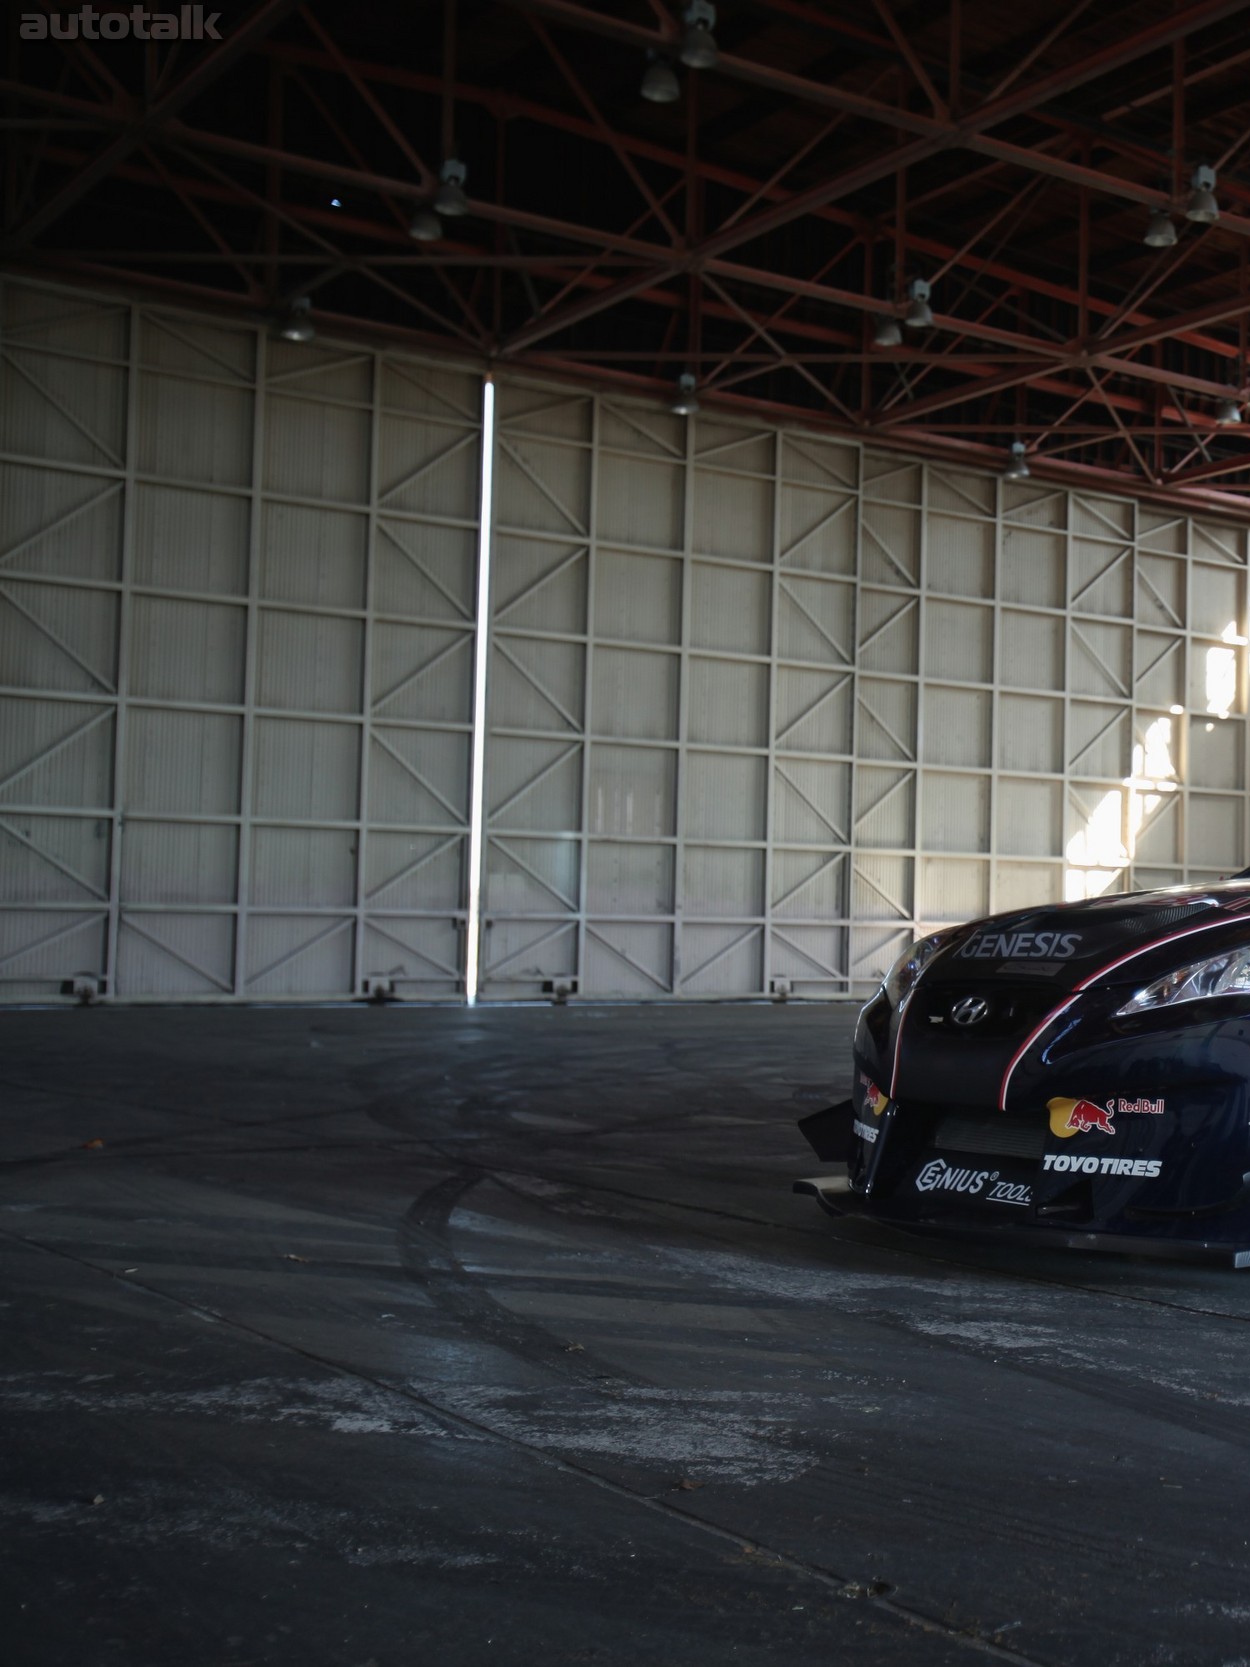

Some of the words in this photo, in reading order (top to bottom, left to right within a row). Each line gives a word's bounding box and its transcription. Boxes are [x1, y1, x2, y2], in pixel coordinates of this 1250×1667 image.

[960, 932, 1083, 958] GENESIS
[1118, 1098, 1141, 1113] Red
[1141, 1099, 1165, 1114] Bull
[1043, 1154, 1100, 1174] TOYO
[1100, 1157, 1162, 1178] TIRES
